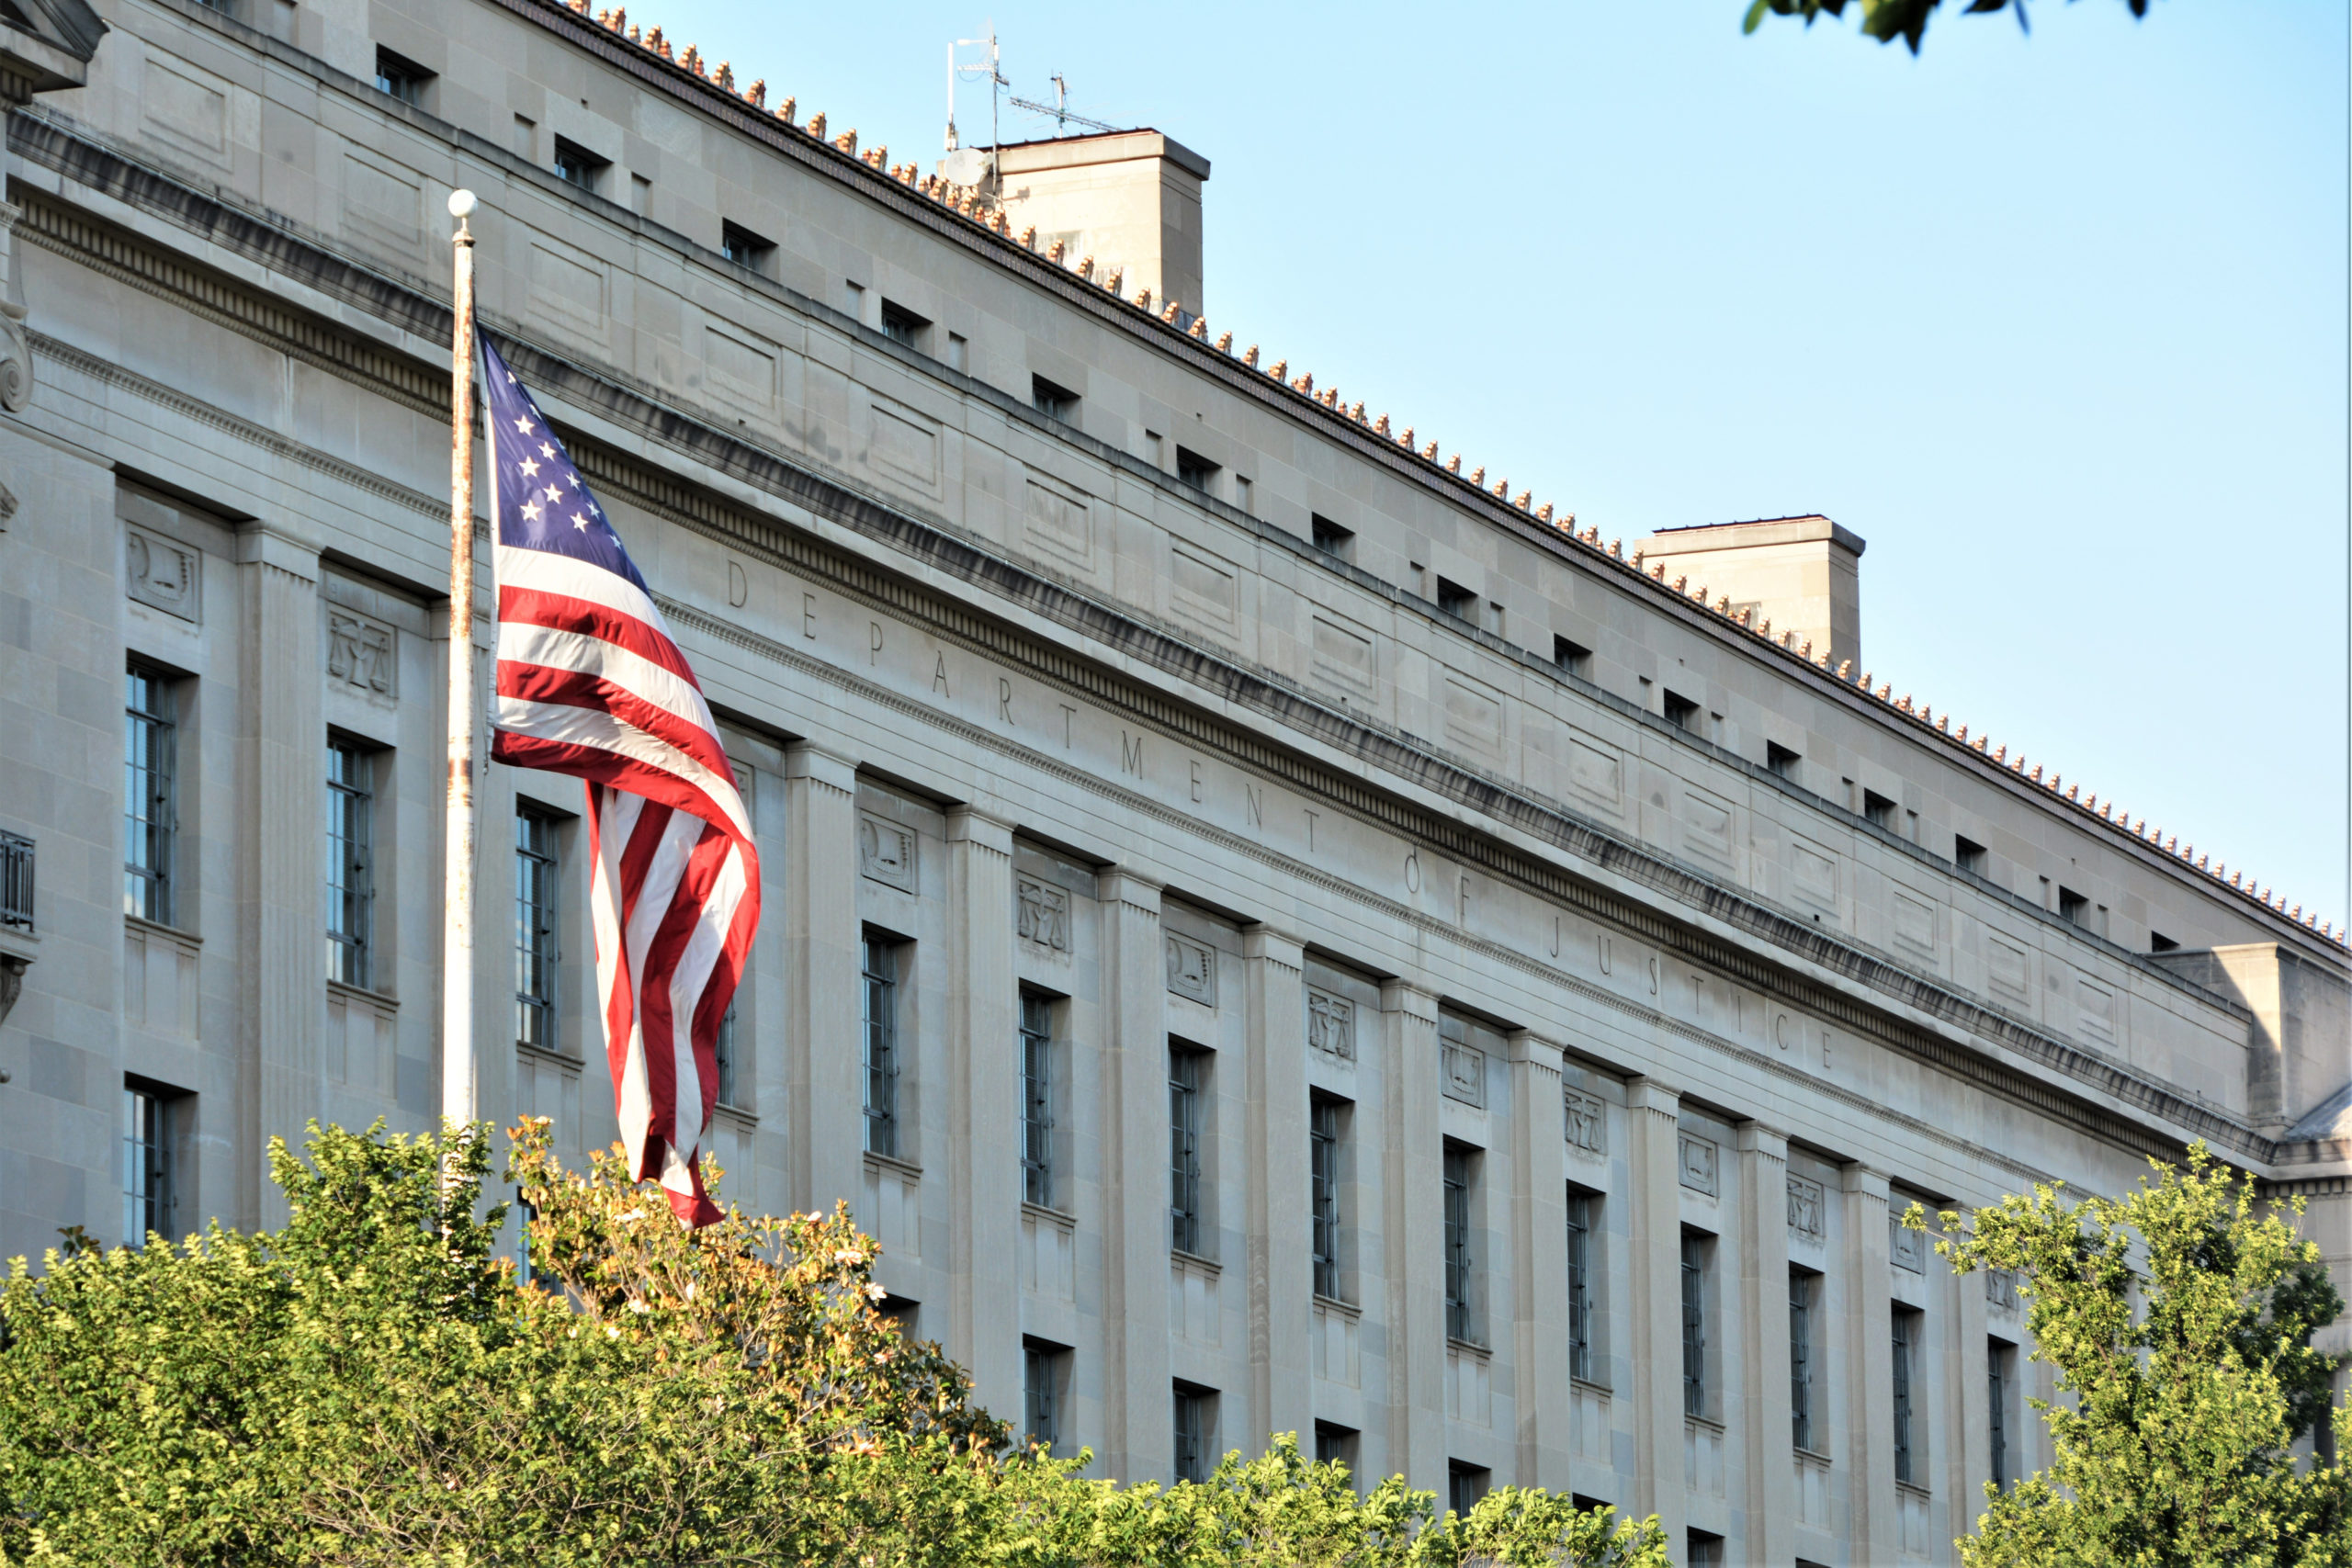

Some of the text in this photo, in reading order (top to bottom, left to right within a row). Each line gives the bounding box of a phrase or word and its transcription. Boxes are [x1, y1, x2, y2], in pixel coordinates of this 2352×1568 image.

[729, 559, 1831, 1069] DEPARTMENT OF JUSTICE
